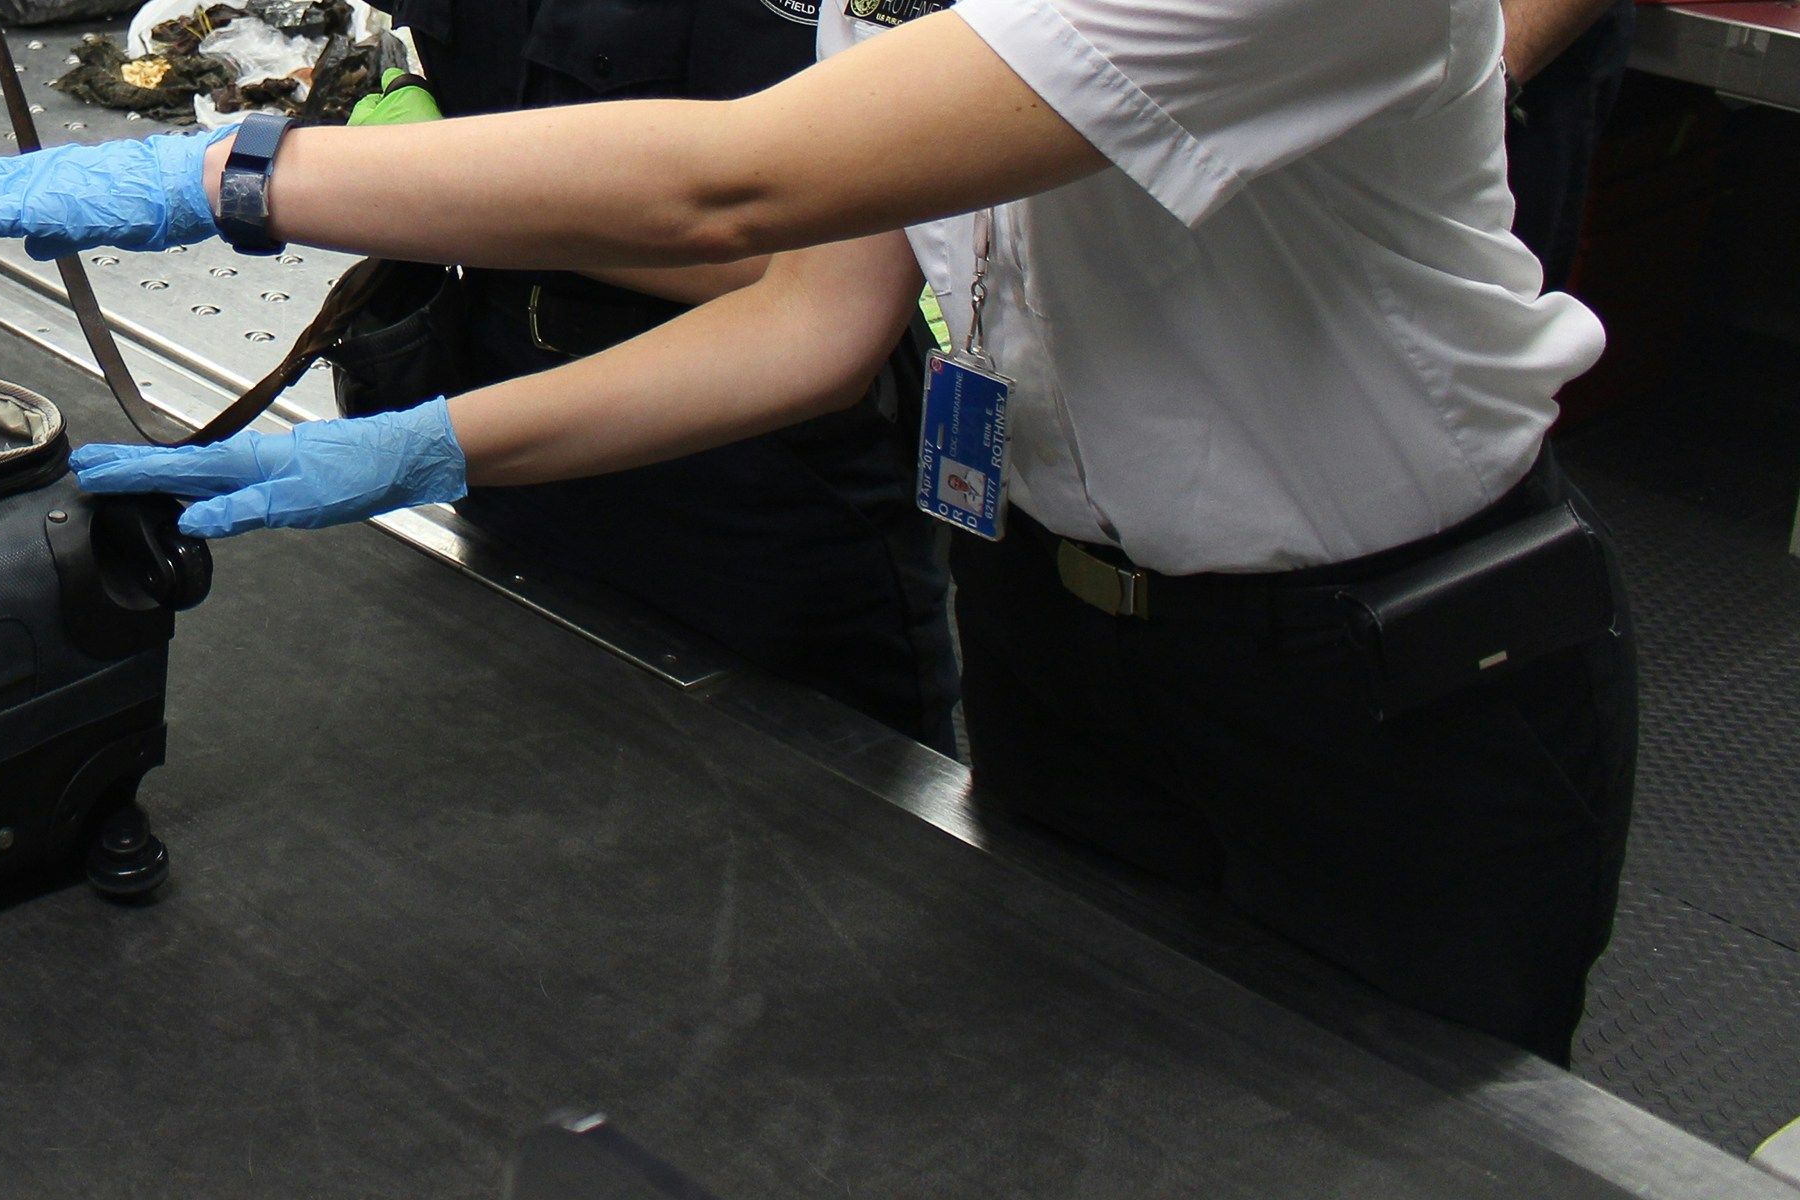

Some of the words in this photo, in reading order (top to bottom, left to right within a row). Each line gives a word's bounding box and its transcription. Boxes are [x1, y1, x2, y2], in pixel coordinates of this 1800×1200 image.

[784, 0, 816, 16] FIELD
[951, 371, 964, 435] QUARANTINE
[983, 422, 993, 448] ERIN
[990, 392, 1006, 469] ROTHNEY
[922, 438, 935, 471] 2017
[921, 474, 934, 496] Apr
